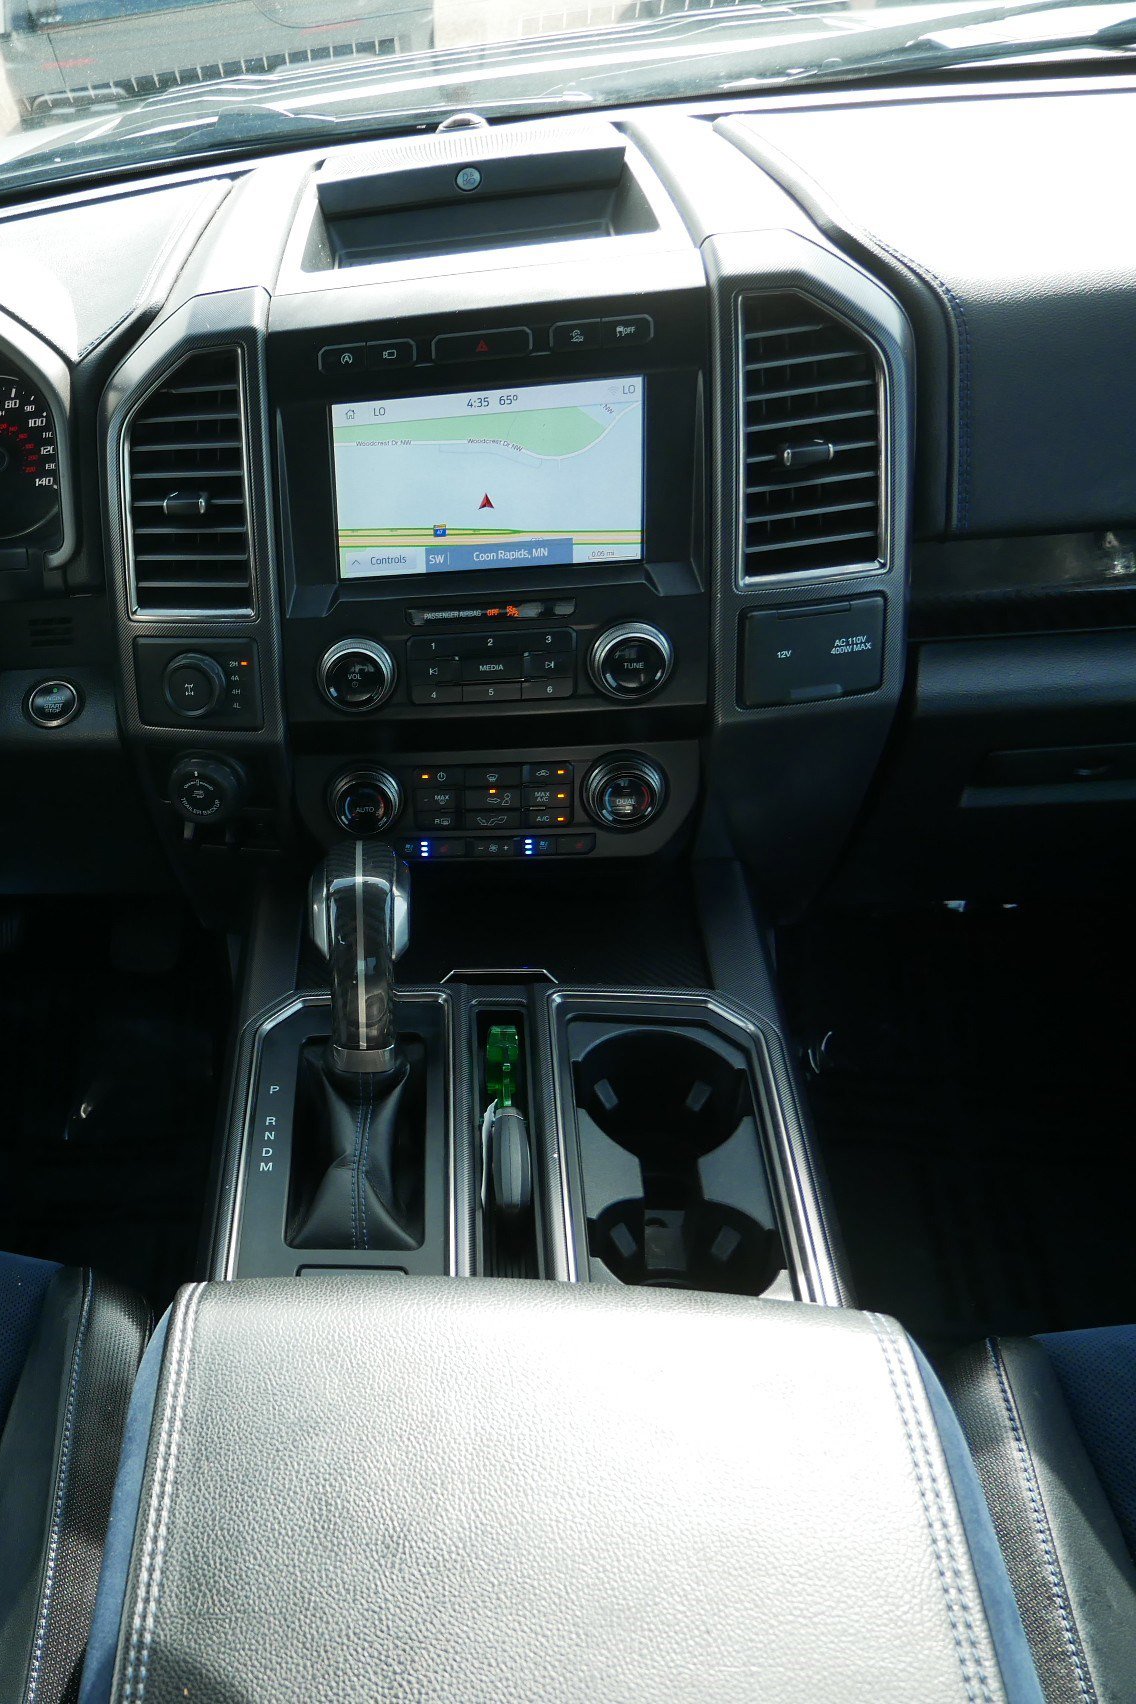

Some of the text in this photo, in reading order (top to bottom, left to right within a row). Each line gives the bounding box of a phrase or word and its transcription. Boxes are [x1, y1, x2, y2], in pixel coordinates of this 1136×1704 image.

[622, 385, 636, 395] LO
[5, 400, 19, 408] 80
[466, 396, 490, 409] 4:35
[373, 407, 386, 417] LO
[28, 418, 46, 427] 100
[510, 443, 523, 452] NW
[35, 477, 53, 487] 140
[429, 554, 445, 564] SW
[473, 548, 548, 561] Coon Rapids, MN
[370, 555, 407, 566] Controls
[424, 608, 500, 620] PASSENGER AIRBAG OFF
[834, 635, 867, 646] AC 110V
[830, 642, 872, 655] 400W MAX
[777, 650, 792, 659] 12V
[479, 663, 504, 672] MEDIA
[624, 661, 644, 670] TUNE
[547, 686, 553, 694] 6
[536, 815, 550, 823] A/C
[270, 1085, 279, 1094] P
[266, 1117, 276, 1125] R
[265, 1131, 275, 1140] N
[262, 1148, 273, 1156] D
[260, 1163, 273, 1171] M
